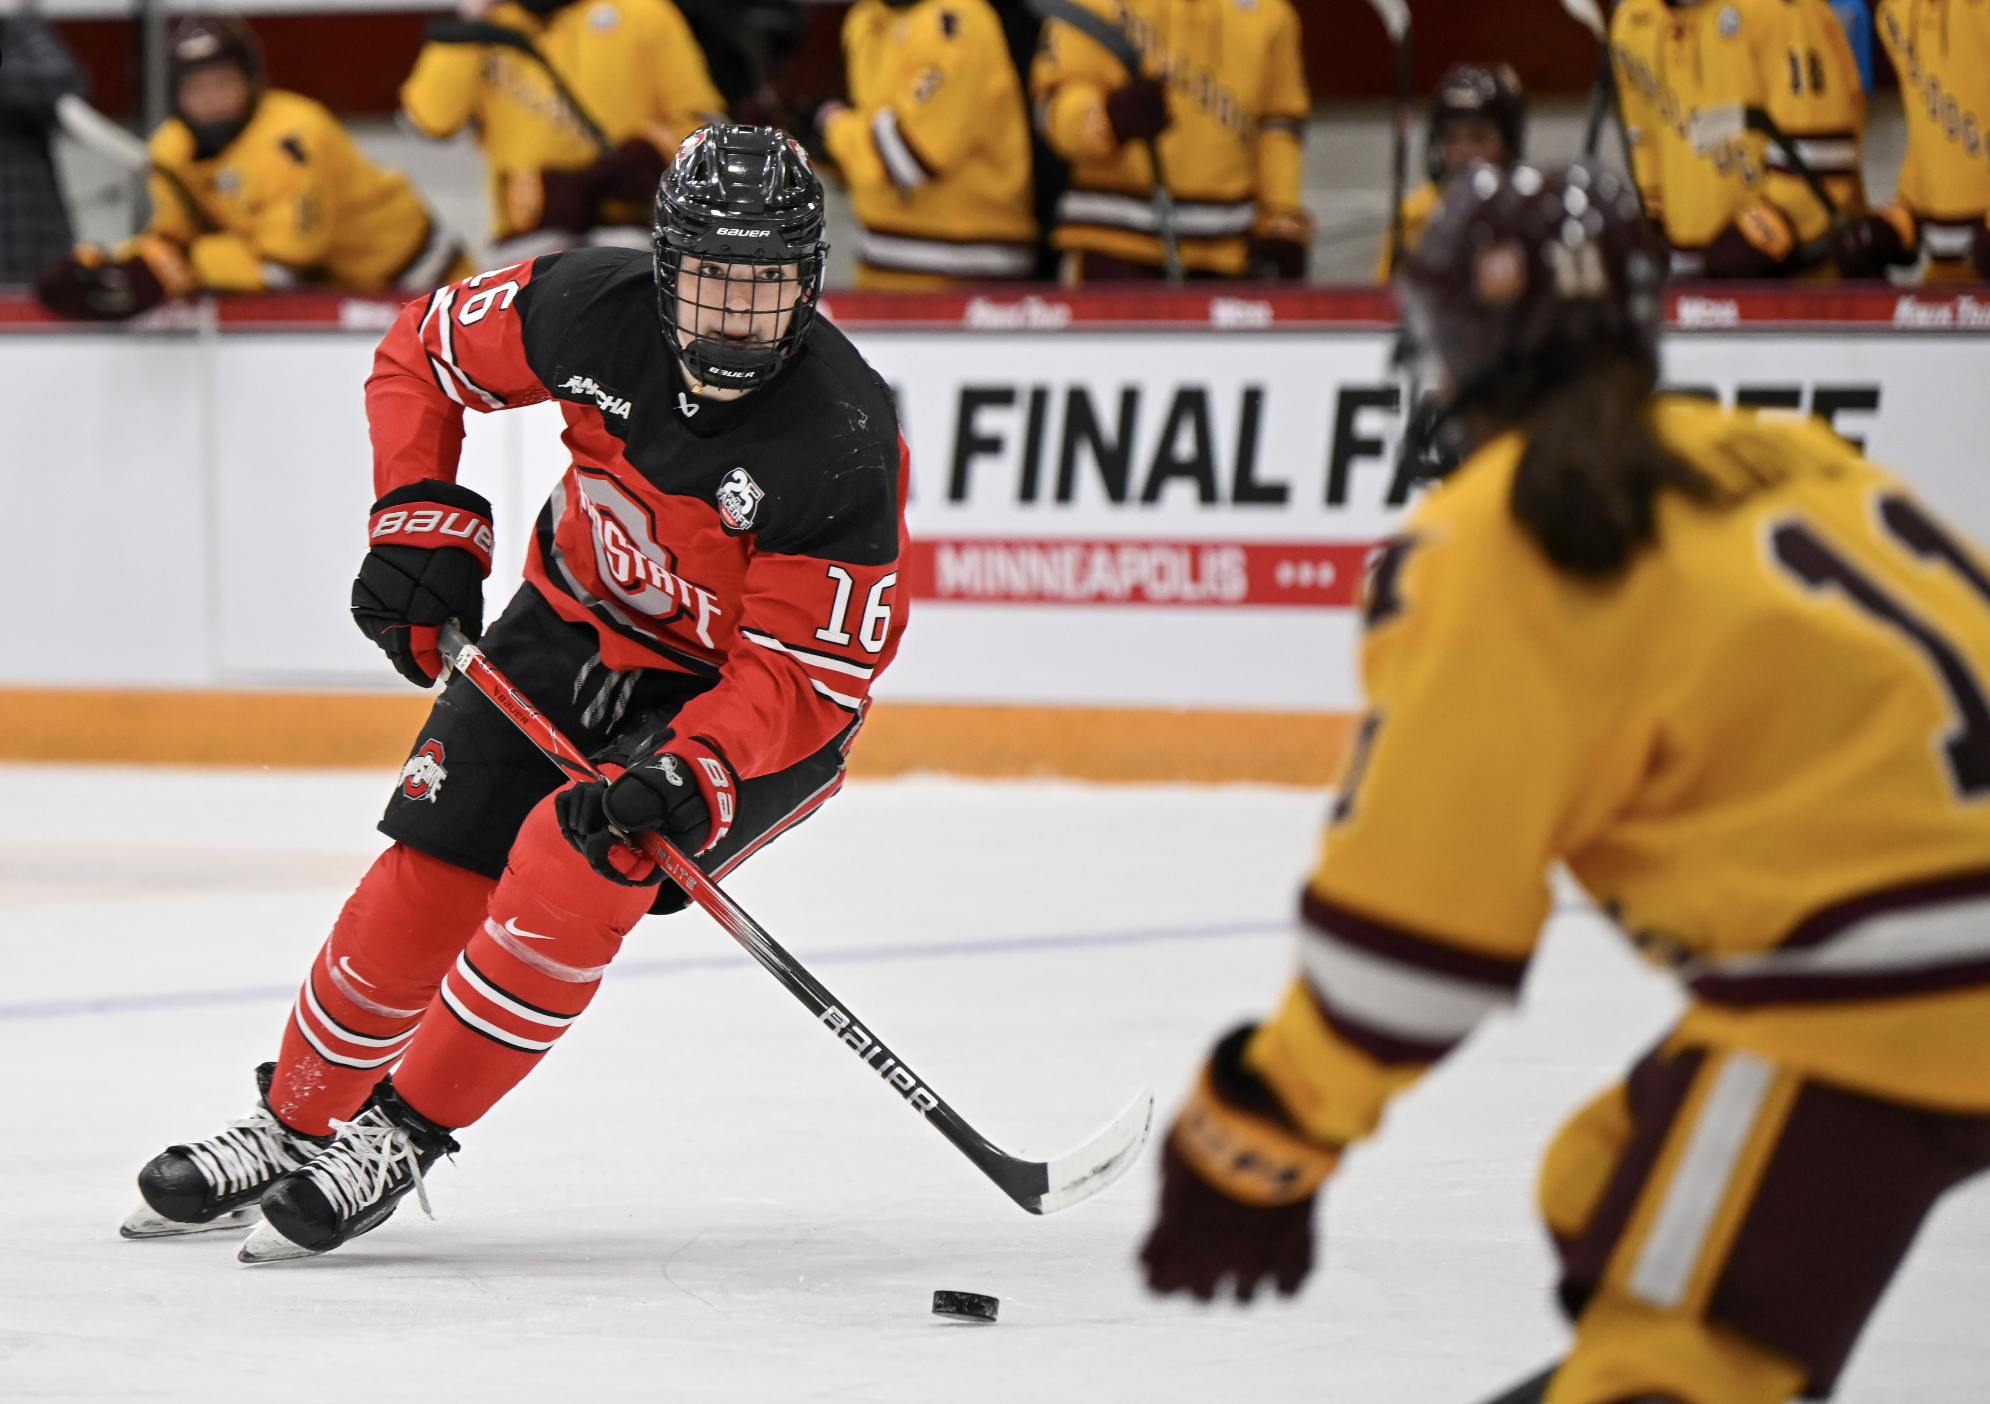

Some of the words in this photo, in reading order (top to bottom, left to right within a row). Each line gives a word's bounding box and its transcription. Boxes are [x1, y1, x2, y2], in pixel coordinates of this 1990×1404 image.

[716, 227, 771, 238] BAUER
[708, 366, 755, 378] BAUER
[945, 384, 1293, 507] FINAL
[723, 470, 754, 515] 25
[603, 520, 722, 649] STATE
[935, 546, 1248, 601] MINNEAPOLIS
[814, 563, 898, 654] 16
[499, 694, 529, 725] BAUER
[818, 1004, 939, 1118] BAUER
